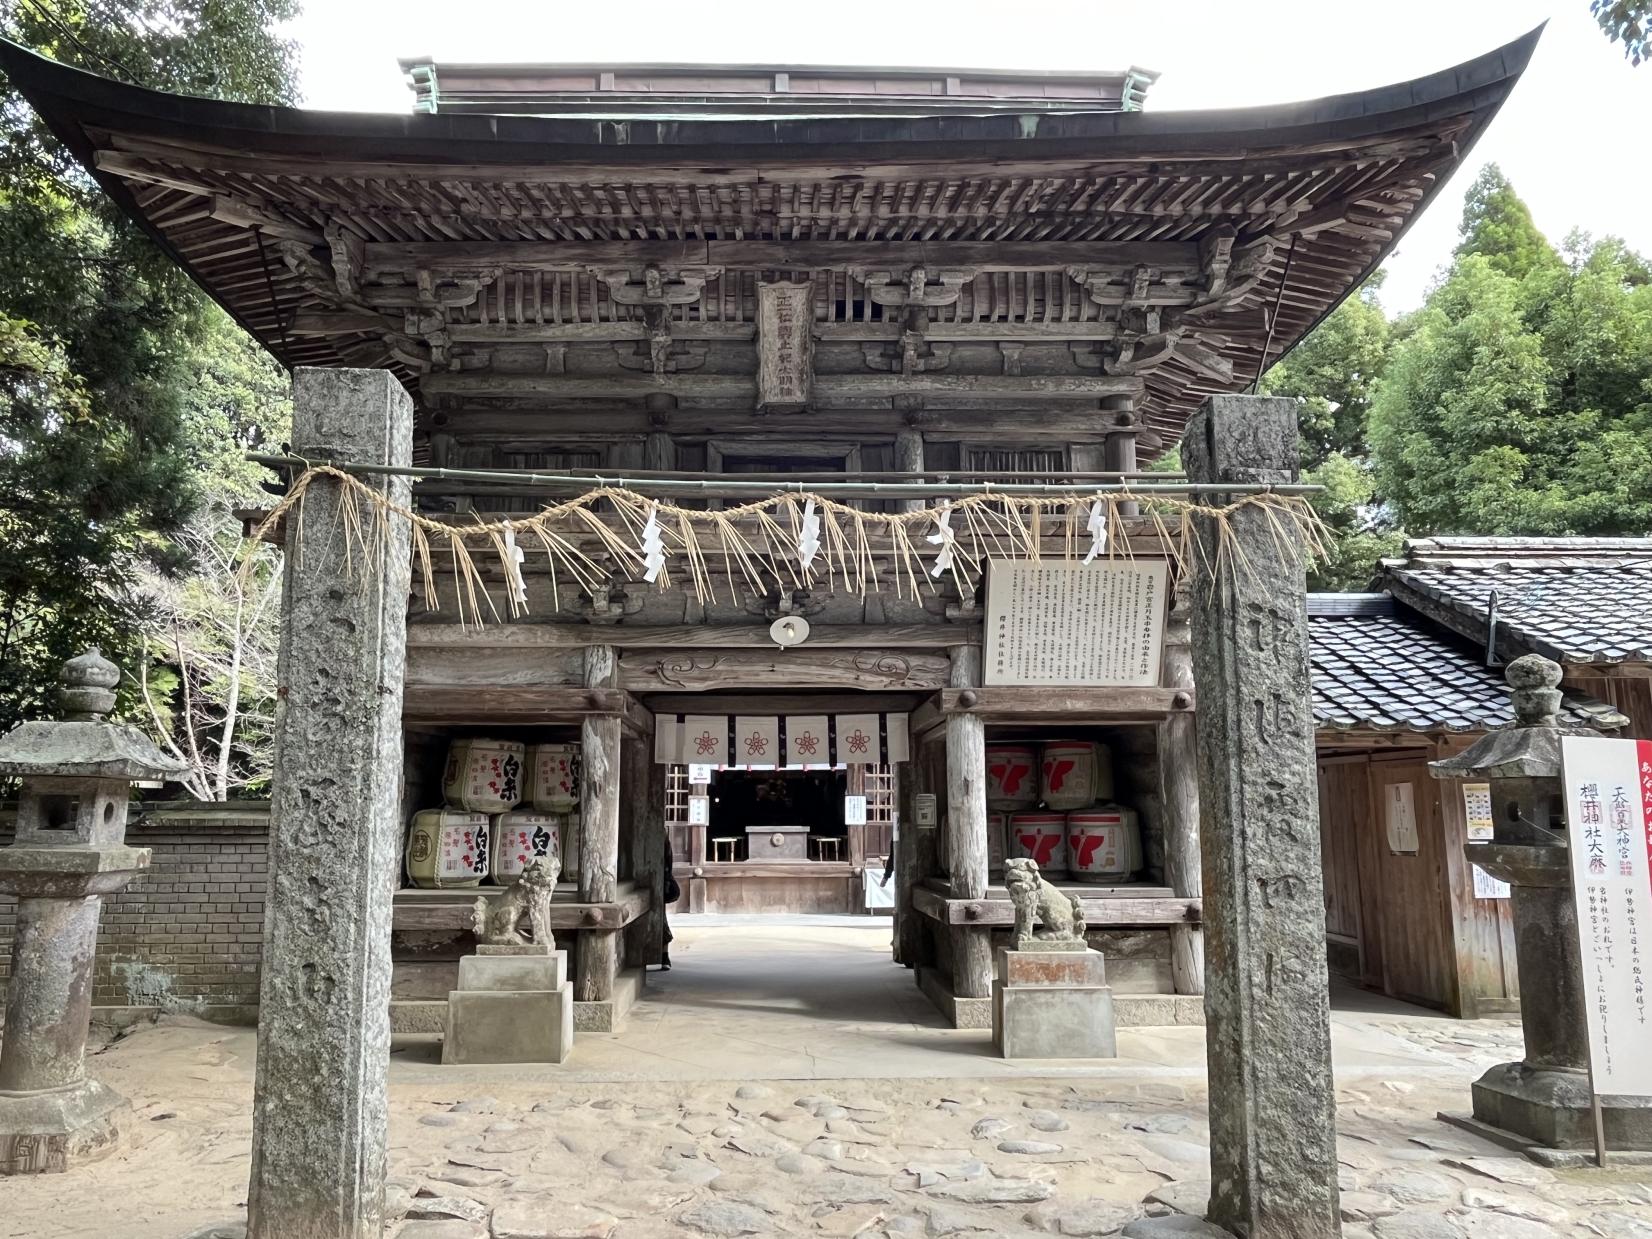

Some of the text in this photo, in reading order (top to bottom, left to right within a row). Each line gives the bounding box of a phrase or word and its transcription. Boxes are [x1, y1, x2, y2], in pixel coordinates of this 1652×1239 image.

[500, 754, 520, 801] 白糸
[474, 825, 488, 874] 白糸
[532, 825, 551, 857] 白
